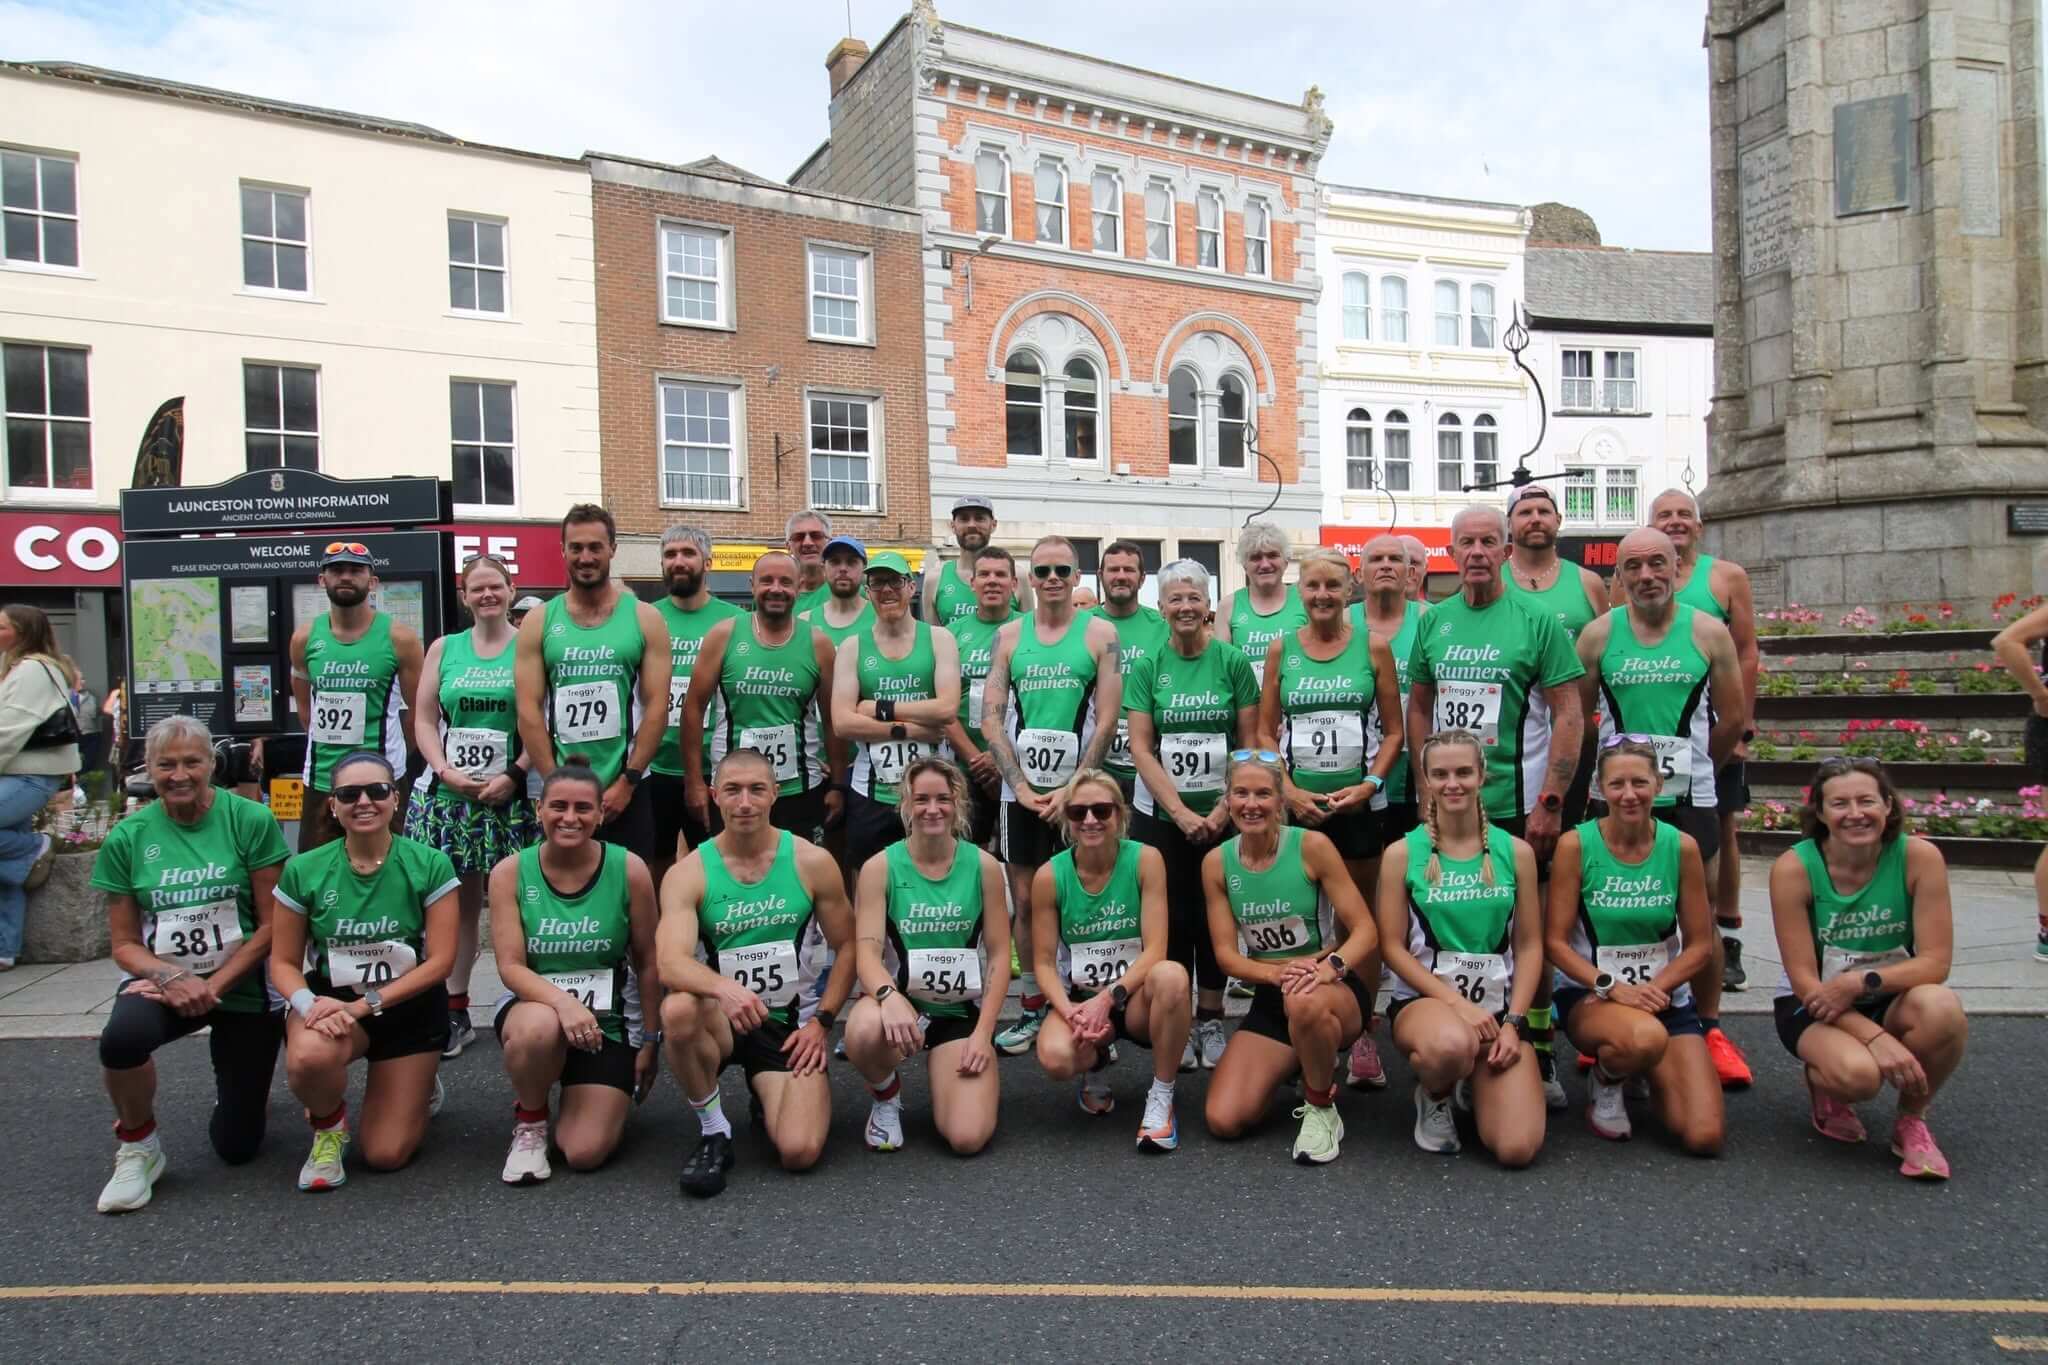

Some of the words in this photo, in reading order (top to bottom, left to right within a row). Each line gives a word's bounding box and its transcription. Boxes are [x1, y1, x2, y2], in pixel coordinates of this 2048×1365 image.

[168, 499, 253, 512] LAUNCESTON
[256, 498, 294, 510] TOWN
[298, 494, 390, 508] INFORMATION
[250, 545, 310, 557] WELCOME
[1334, 544, 1364, 556] Briti
[1584, 544, 1617, 565] HB
[172, 564, 196, 572] PLEASE
[240, 562, 262, 570] TOWN
[672, 636, 704, 654] Hayl
[1443, 644, 1500, 664] Hayle
[563, 645, 615, 664] Hayle
[1122, 646, 1144, 664] yle
[322, 660, 370, 677] Hayle
[464, 666, 512, 680] Hayle
[557, 663, 624, 677] Runners
[1026, 663, 1071, 680] Hayle
[1435, 663, 1511, 680] Runners
[1621, 656, 1681, 672] Hayle
[316, 675, 377, 688] Runners
[744, 666, 794, 684] Hayle
[879, 674, 920, 692] Hayle
[1296, 674, 1352, 692] Hayle
[1612, 672, 1692, 686] Runners
[568, 688, 594, 697] Treggy
[736, 681, 802, 697] Runners
[1020, 677, 1080, 693] Runners
[1448, 686, 1476, 696] Treggy
[460, 696, 508, 712] Claire
[1170, 690, 1219, 710] Hayle
[1288, 690, 1364, 706] Runners
[318, 708, 352, 730] 392
[566, 700, 608, 728] 279
[1162, 708, 1229, 724] Runners
[1445, 700, 1485, 730] 382
[1312, 730, 1338, 756] 91
[454, 745, 494, 768] 389
[880, 742, 920, 768] 218
[1026, 746, 1066, 772] 307
[1172, 752, 1210, 776] 391
[159, 862, 227, 886] Hayle
[1440, 870, 1483, 888] Hayl
[1602, 875, 1662, 895] Hayle
[150, 884, 240, 908] Runners
[1426, 886, 1510, 903] Runners
[1591, 890, 1672, 908] Runners
[726, 894, 786, 920] Hayle
[909, 902, 962, 920] Hayle
[1242, 898, 1290, 916] Hayle
[1828, 904, 1892, 928] Hayle
[334, 916, 399, 938] Hayle
[536, 916, 600, 938] Hayle
[715, 912, 798, 936] Runners
[899, 919, 972, 934] Runners
[1818, 920, 1907, 942] Runners
[170, 924, 223, 957] 381
[528, 936, 612, 954] Runners
[1251, 924, 1296, 951] 306
[348, 948, 384, 956] Treggy
[736, 950, 768, 960] Treggy
[926, 954, 956, 964] Treggy
[960, 954, 964, 962] 7
[1087, 946, 1118, 956] Treggy
[1120, 944, 1125, 952] 7
[356, 960, 392, 985] 70
[552, 976, 586, 984] Treggy
[922, 970, 967, 996] 354
[1454, 974, 1485, 1003] 36
